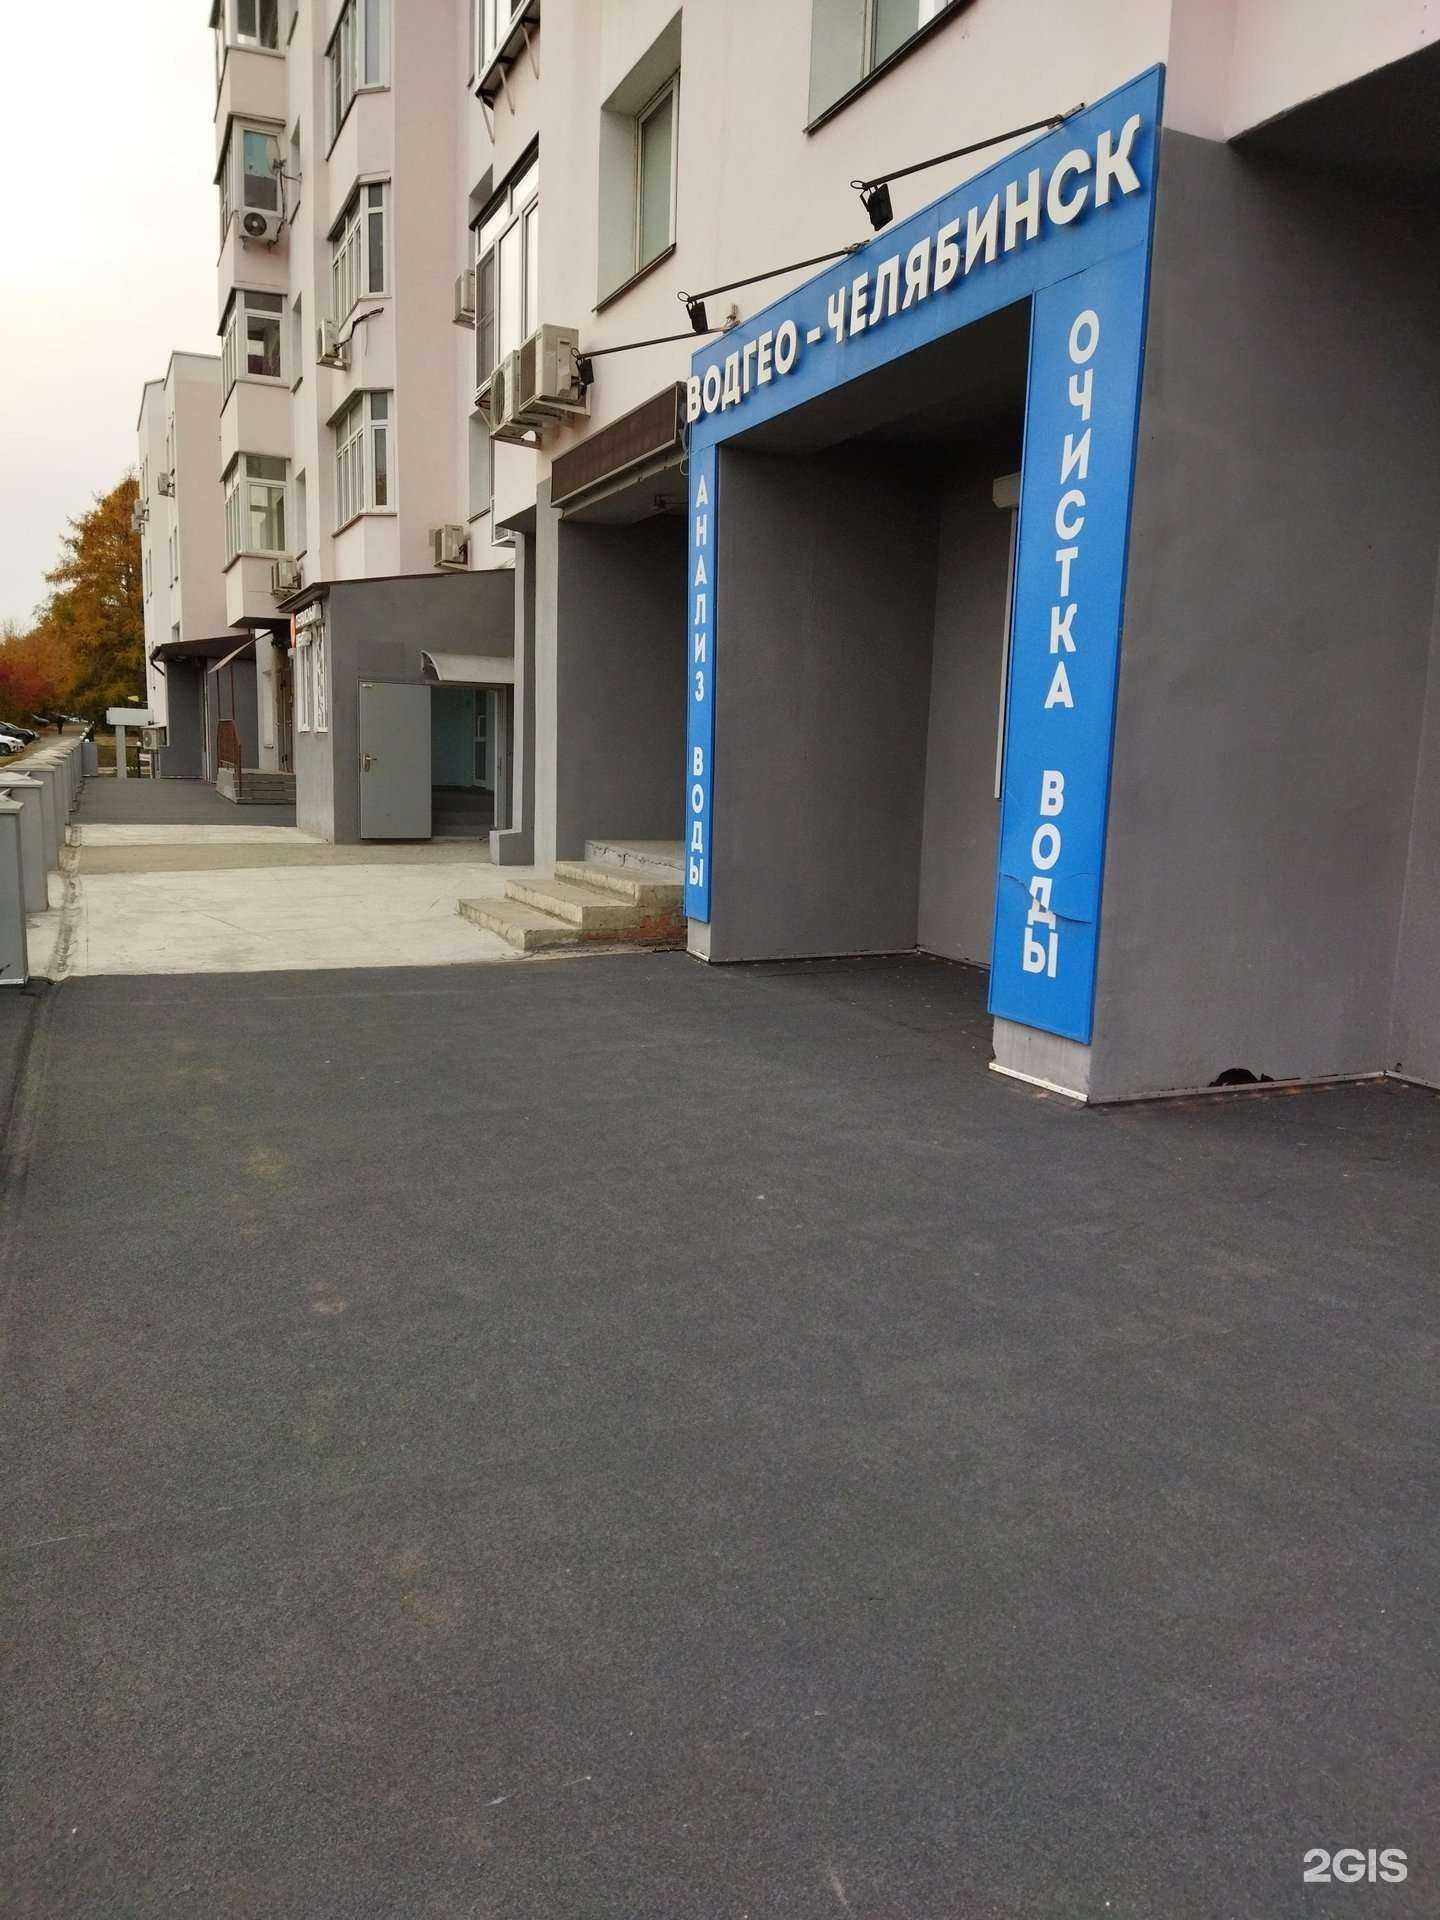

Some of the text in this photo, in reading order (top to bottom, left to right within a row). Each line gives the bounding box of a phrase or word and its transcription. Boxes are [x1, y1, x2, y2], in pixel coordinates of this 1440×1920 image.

[686, 319, 798, 424] ВОДГЕО
[828, 113, 1142, 345] ЧЕЛЯБИНСК
[688, 474, 709, 888] АНАЛИЗ ВОДЫ
[1022, 309, 1100, 978] ОЧИСТКА ВОДЫ
